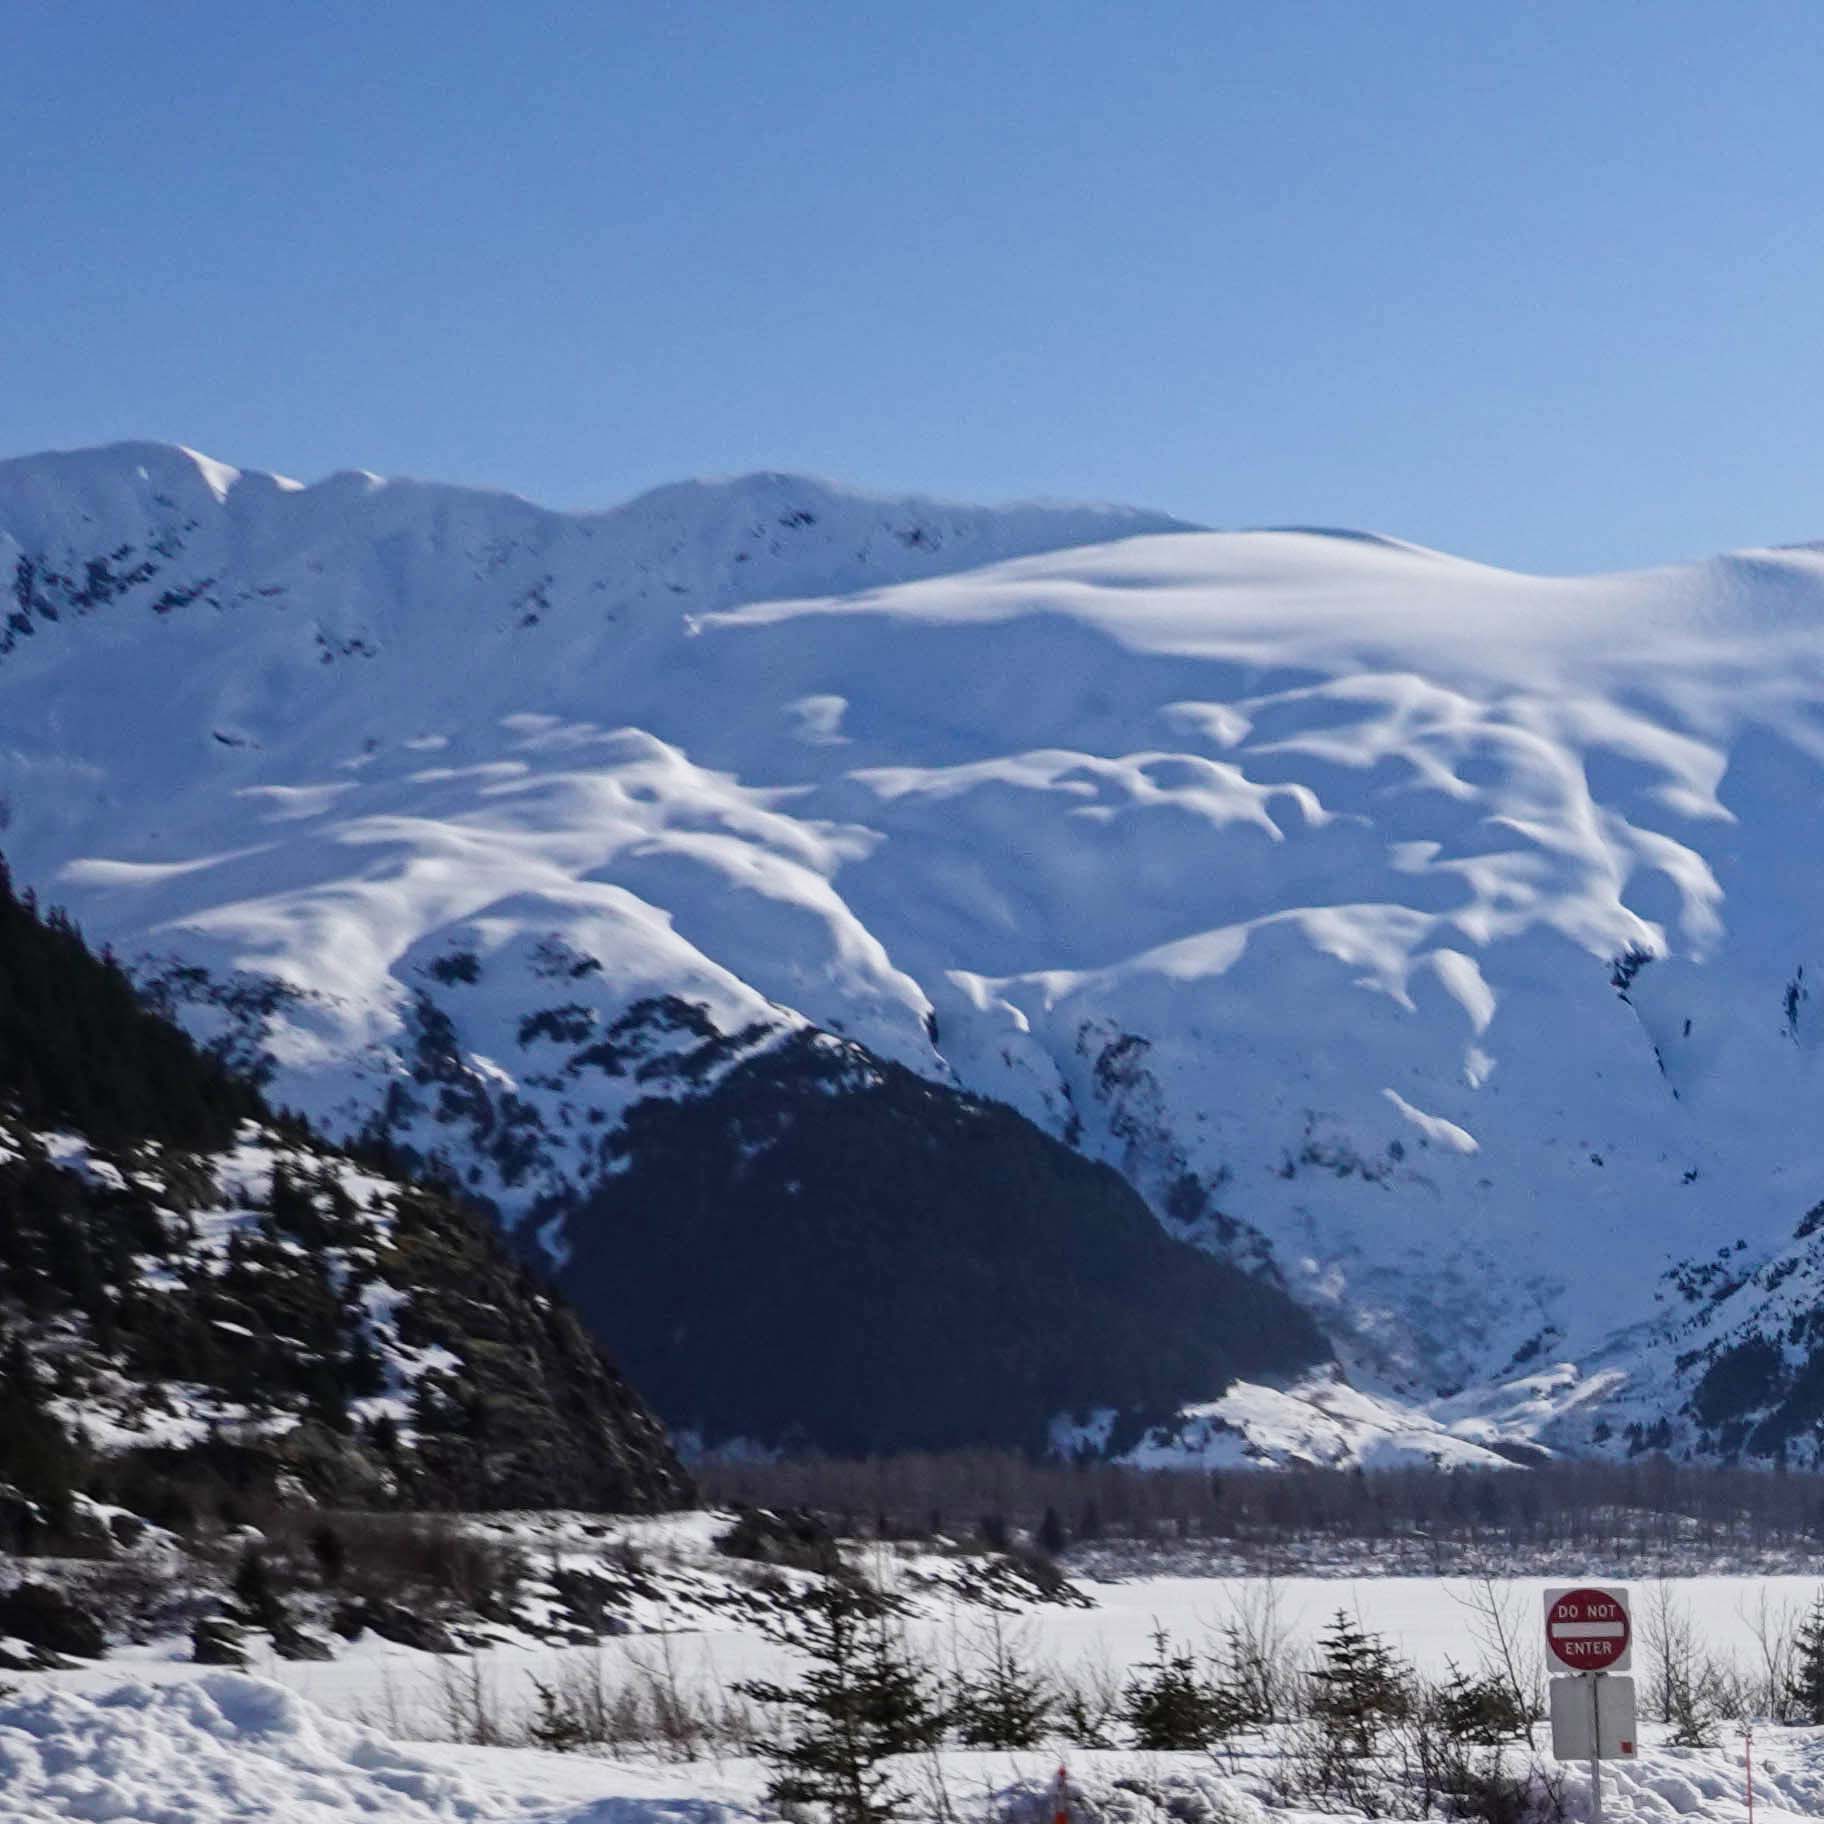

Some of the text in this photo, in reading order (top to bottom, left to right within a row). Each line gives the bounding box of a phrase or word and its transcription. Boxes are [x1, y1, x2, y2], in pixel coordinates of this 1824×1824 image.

[1558, 1604, 1616, 1618] DO NOT
[1565, 1641, 1612, 1655] ENTER
